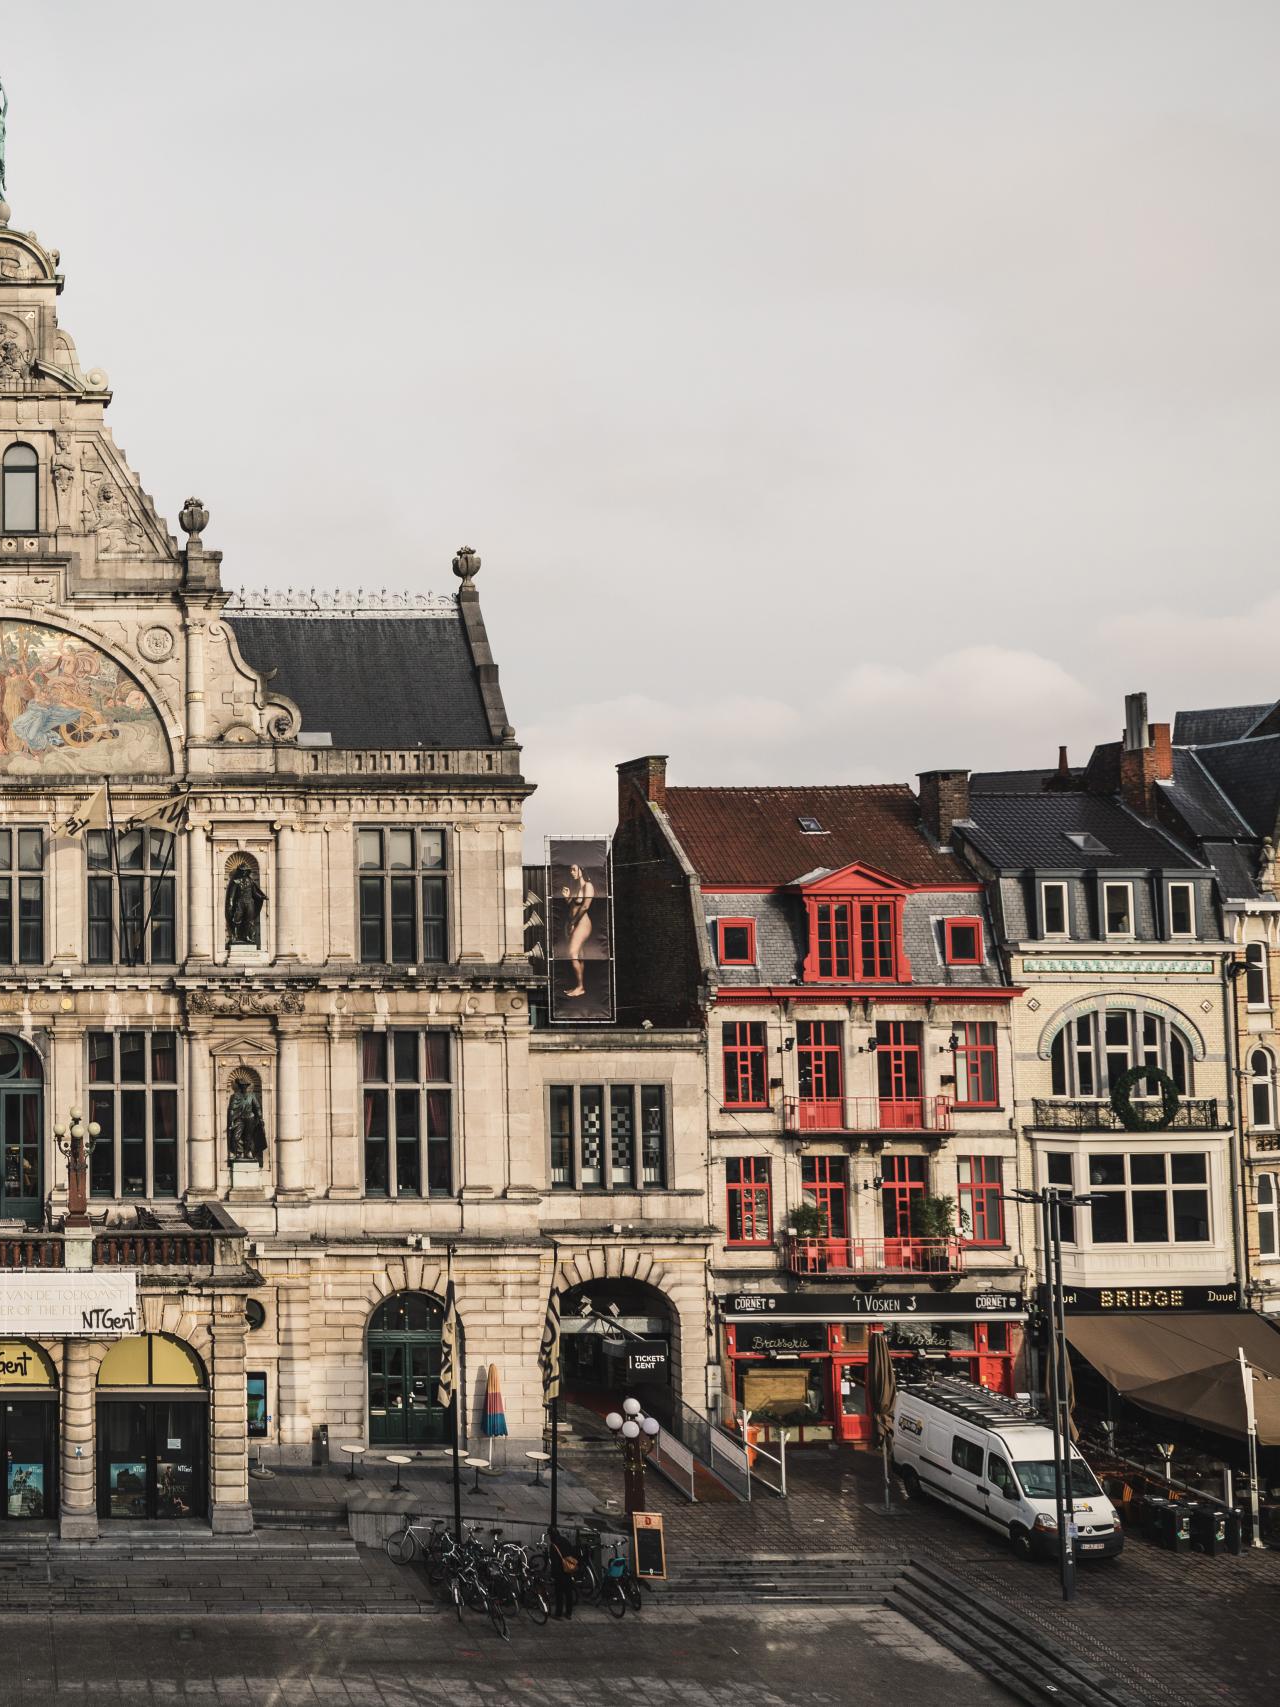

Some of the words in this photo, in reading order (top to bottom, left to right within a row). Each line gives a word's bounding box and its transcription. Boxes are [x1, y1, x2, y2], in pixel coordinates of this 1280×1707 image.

[6, 1289, 33, 1301] VAN
[1100, 1290, 1185, 1307] BRIDGE
[1207, 1291, 1236, 1302] Duvel
[734, 1298, 767, 1310] CORNET
[975, 1296, 1007, 1309] CORNET
[16, 1304, 33, 1316] OF
[39, 1304, 58, 1316] THE
[82, 1307, 137, 1330] NTGent
[752, 1336, 810, 1349] Brasserie
